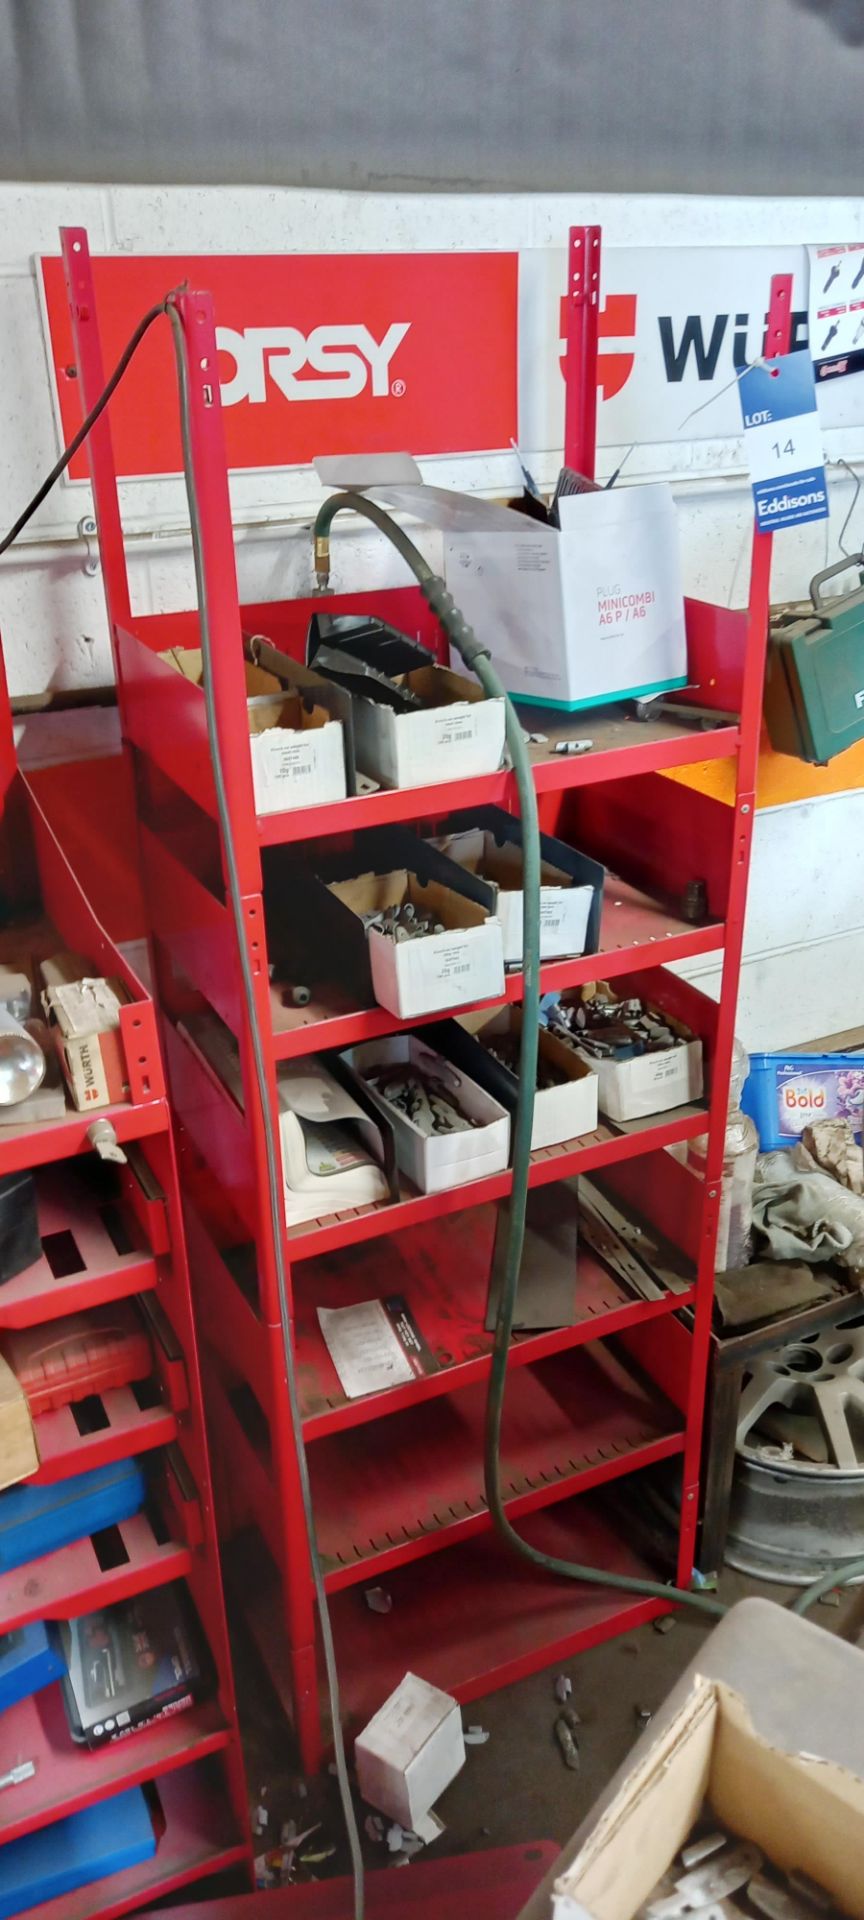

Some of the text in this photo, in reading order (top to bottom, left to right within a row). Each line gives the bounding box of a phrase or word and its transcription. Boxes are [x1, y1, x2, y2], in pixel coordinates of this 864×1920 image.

[772, 438, 796, 459] 14
[757, 490, 826, 517] Eddisons
[596, 584, 621, 598] PLUG
[597, 590, 656, 613] MINICOMBI
[598, 611, 613, 626] A6
[615, 610, 622, 622] P
[632, 605, 646, 619] A6
[785, 1088, 825, 1109] Bold
